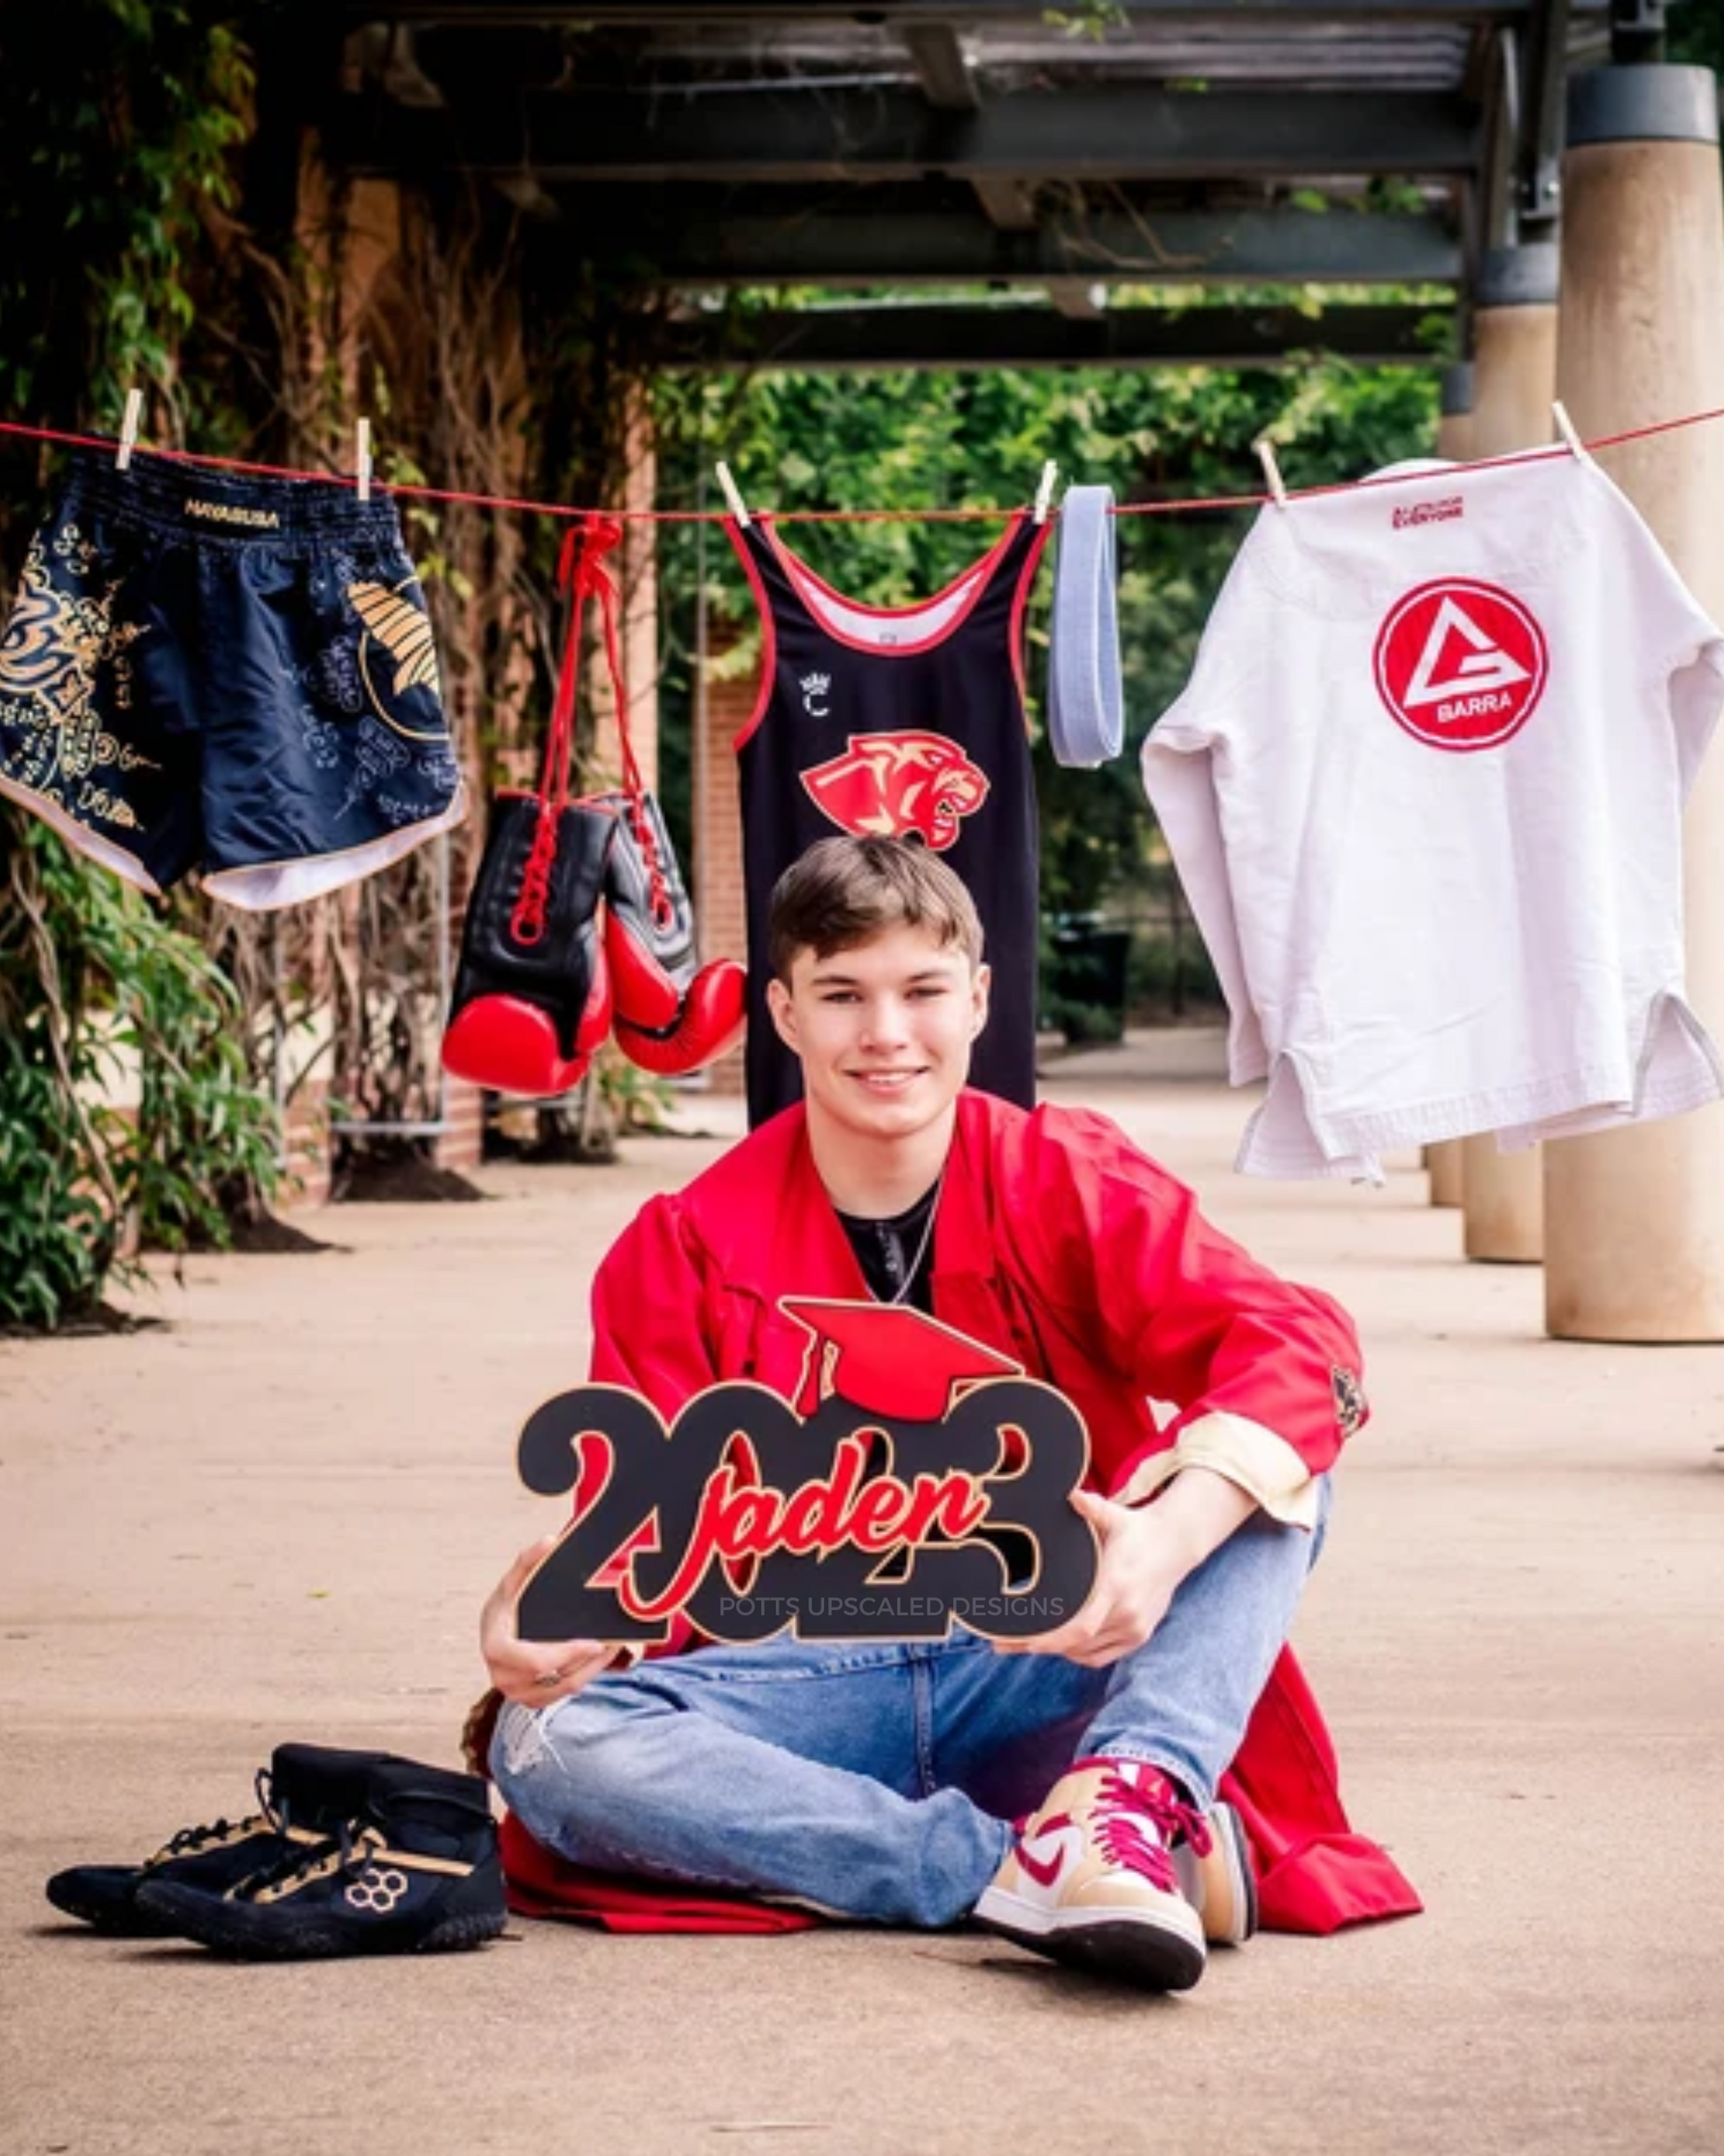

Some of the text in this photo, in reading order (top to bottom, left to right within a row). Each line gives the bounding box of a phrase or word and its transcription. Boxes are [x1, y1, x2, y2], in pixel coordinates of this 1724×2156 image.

[184, 498, 281, 529] HAYABUSA
[1392, 506, 1464, 529] EVERYONE
[1437, 691, 1512, 724] BARRA
[515, 1379, 1102, 1645] 2023
